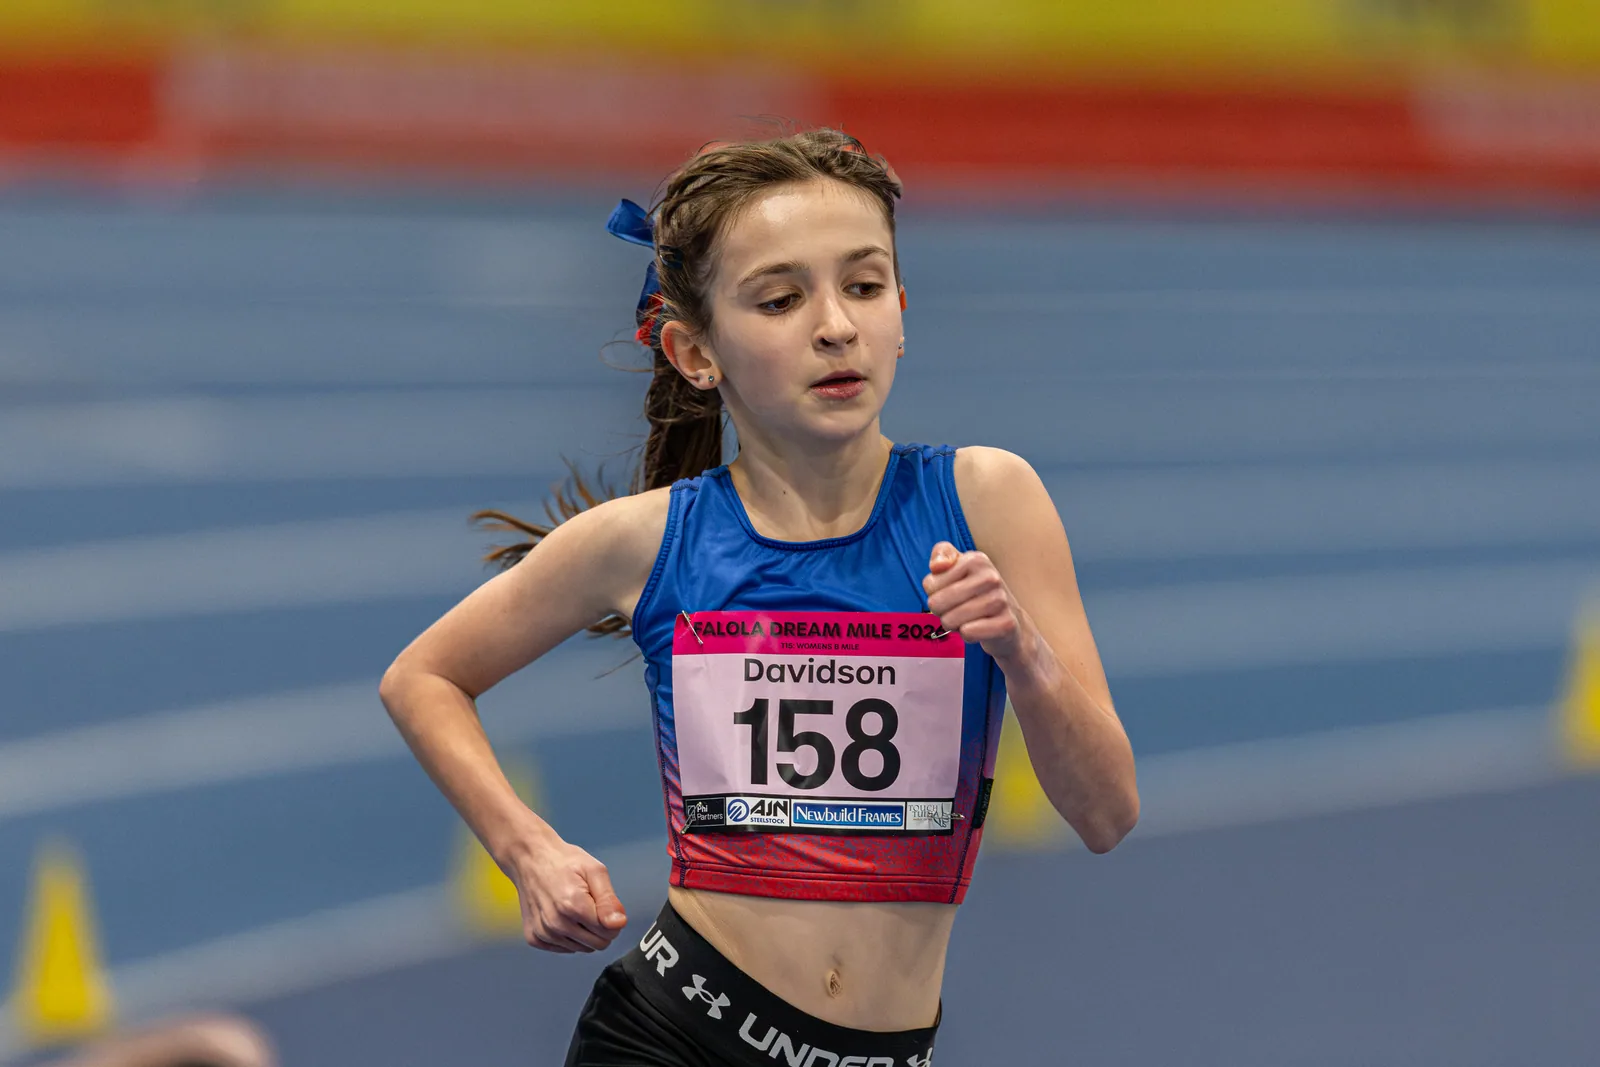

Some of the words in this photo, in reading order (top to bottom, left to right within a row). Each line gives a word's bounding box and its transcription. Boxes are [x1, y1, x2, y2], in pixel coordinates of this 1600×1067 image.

[693, 621, 765, 637] FALOLA
[770, 622, 840, 638] DREAM
[846, 623, 891, 639] MILE
[898, 624, 949, 641] 2026
[744, 658, 896, 685] Davidson
[733, 698, 901, 791] 158
[750, 800, 788, 817] AJN
[908, 804, 938, 812] TOUCH
[750, 817, 785, 825] STEELSTOCK
